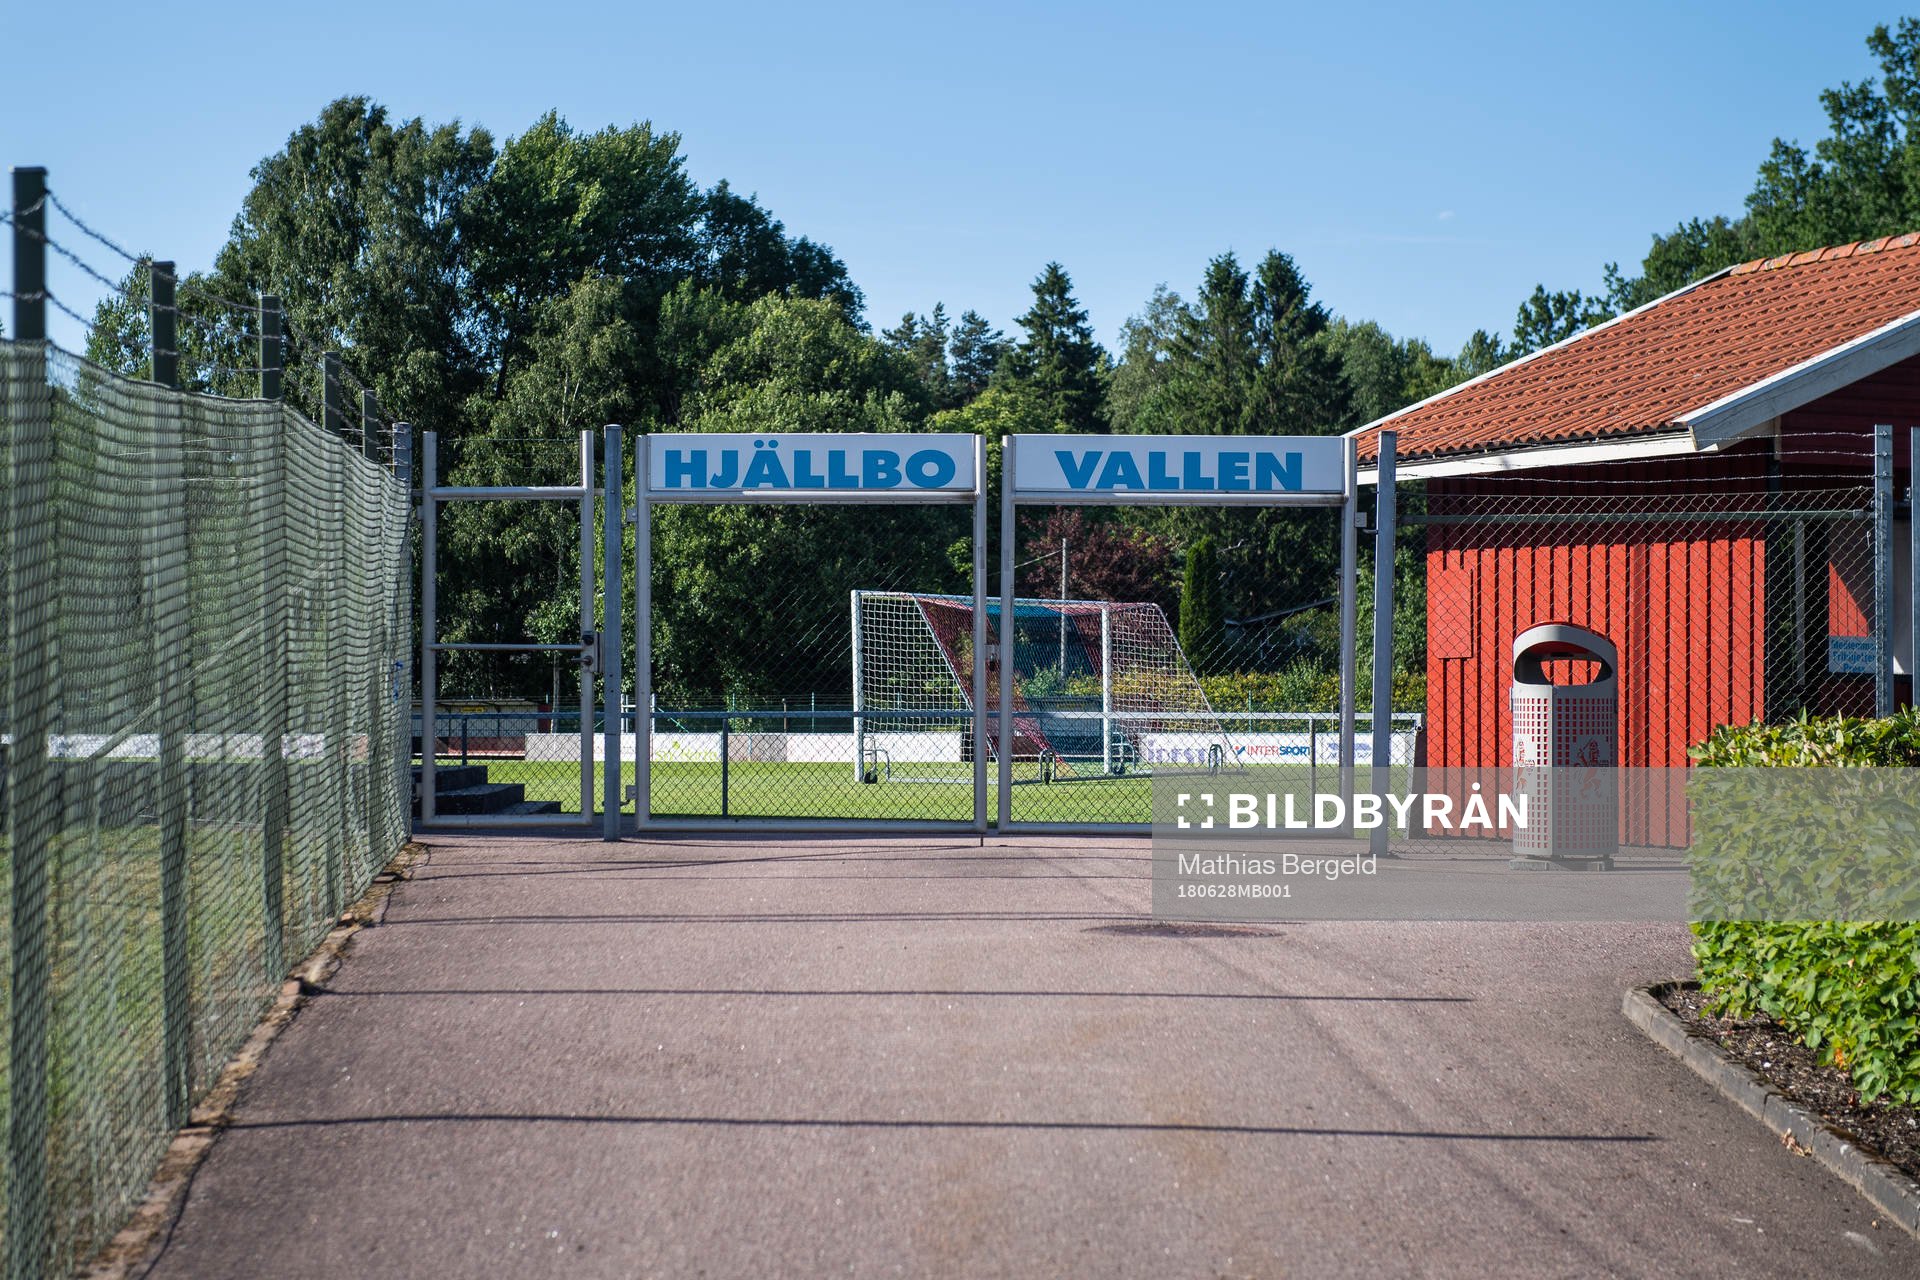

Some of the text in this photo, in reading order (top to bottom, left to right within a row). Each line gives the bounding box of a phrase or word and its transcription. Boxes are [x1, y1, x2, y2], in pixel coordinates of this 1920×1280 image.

[664, 439, 956, 489] HJÄLLBO
[1054, 450, 1303, 490] VALLEN
[1247, 745, 1311, 756] INTERSPORT
